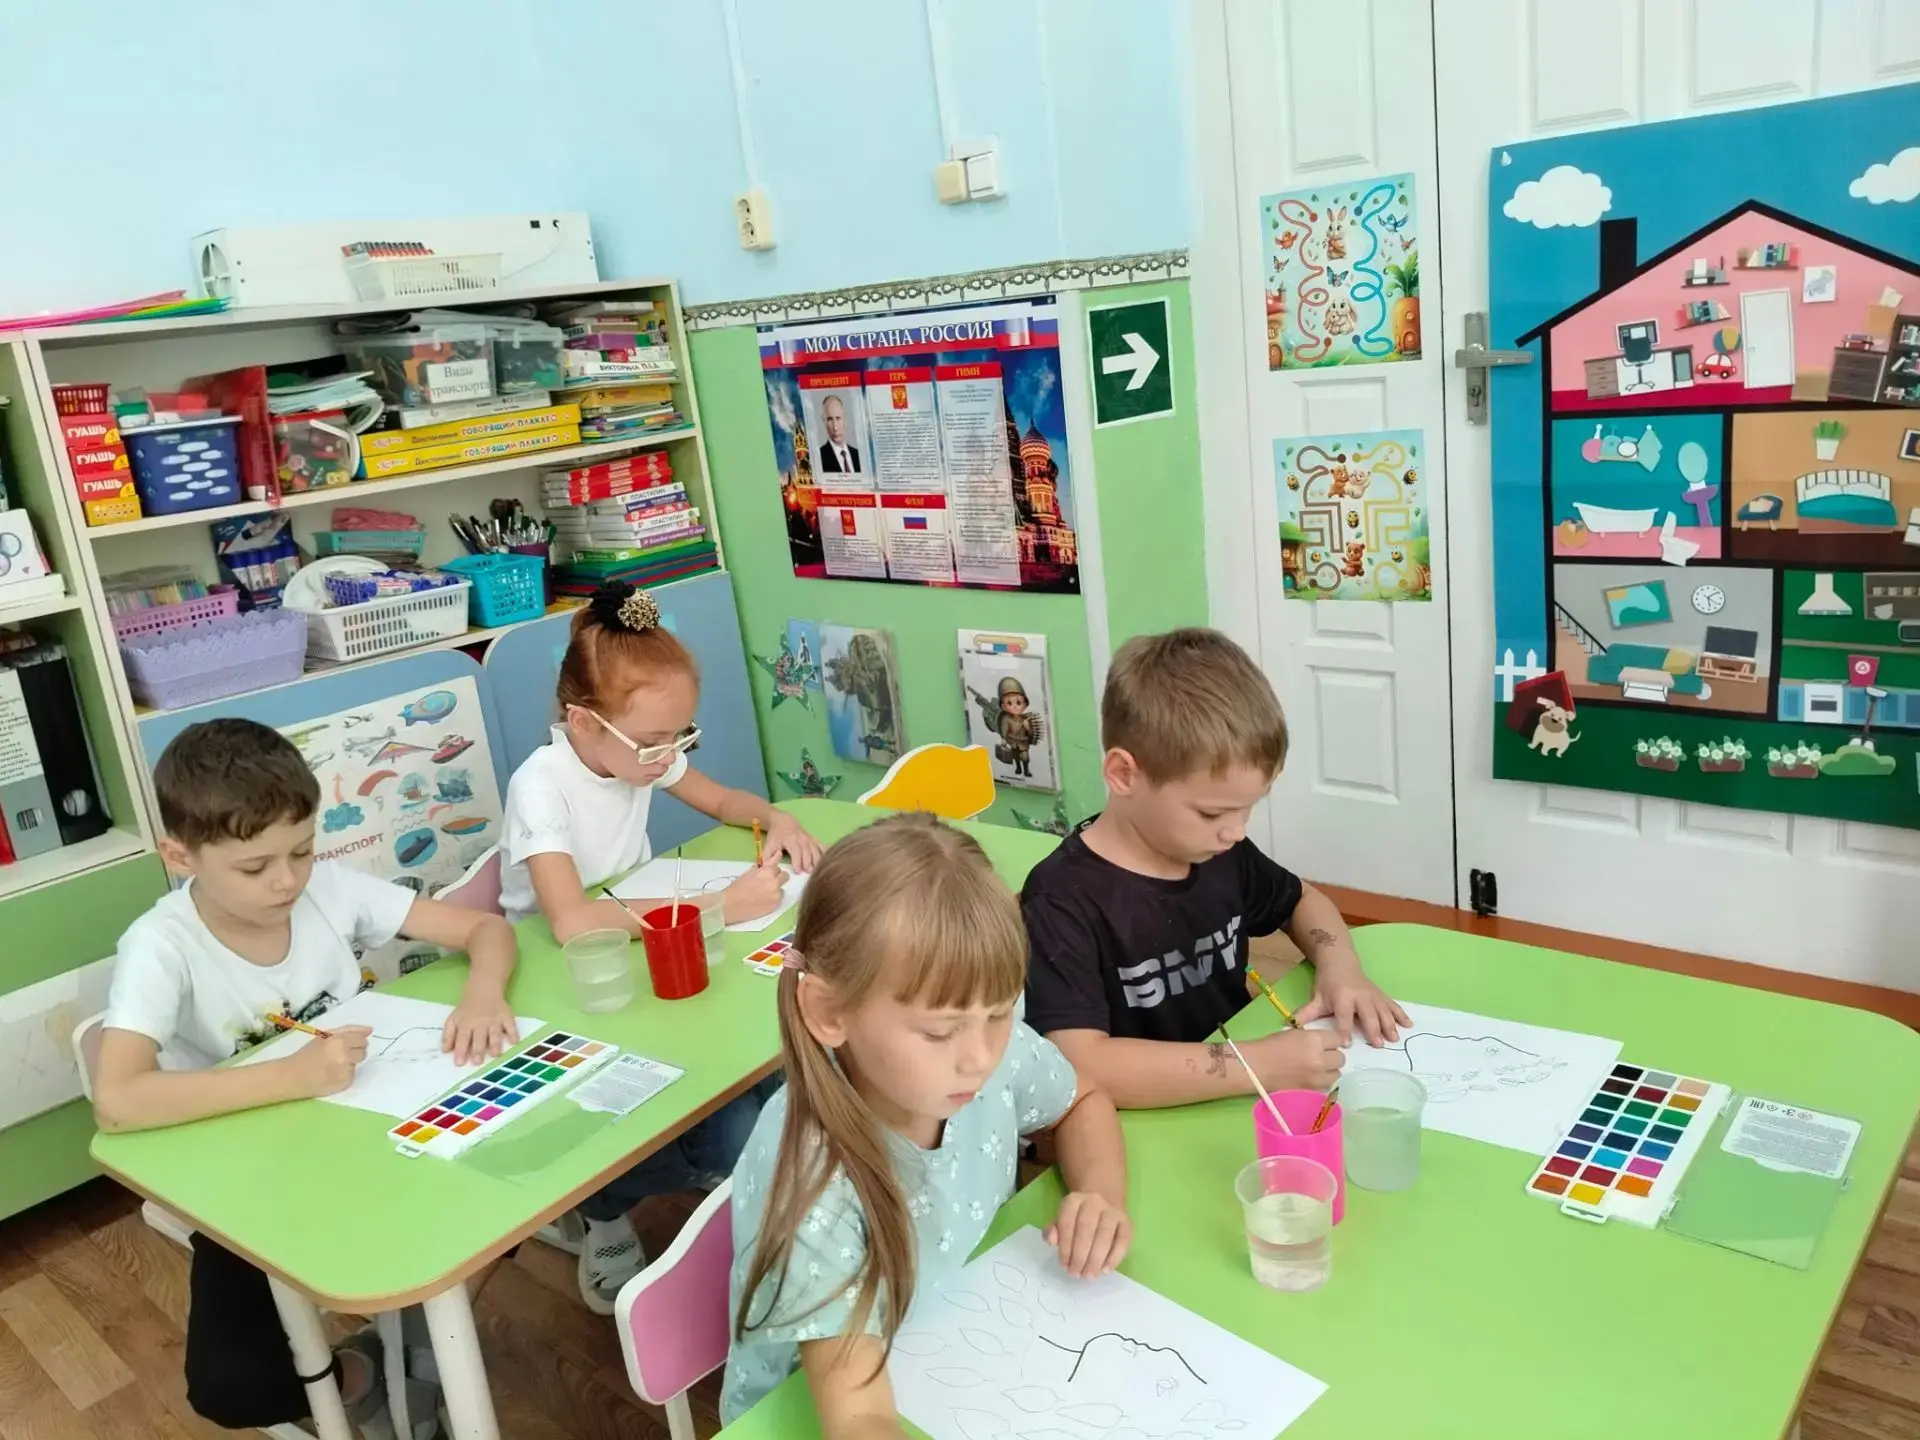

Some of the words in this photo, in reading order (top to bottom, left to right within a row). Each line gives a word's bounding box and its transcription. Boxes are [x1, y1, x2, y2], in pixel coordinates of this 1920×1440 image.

[804, 336, 841, 354] МОЯ
[846, 328, 914, 350] СТРАНА
[920, 321, 994, 344] РОССИЯ
[444, 366, 474, 378] Виды
[955, 366, 981, 377] ГИМН
[67, 424, 107, 438] ГУАШЬ
[462, 419, 516, 436] ГОВОРЯЩИЙ
[464, 441, 516, 457] ГОВОРЯЩИЙ
[76, 451, 116, 465] ГУАШЬ
[83, 479, 122, 493] ГУАШЬ
[313, 832, 385, 863] ТРАНСПОРТ
